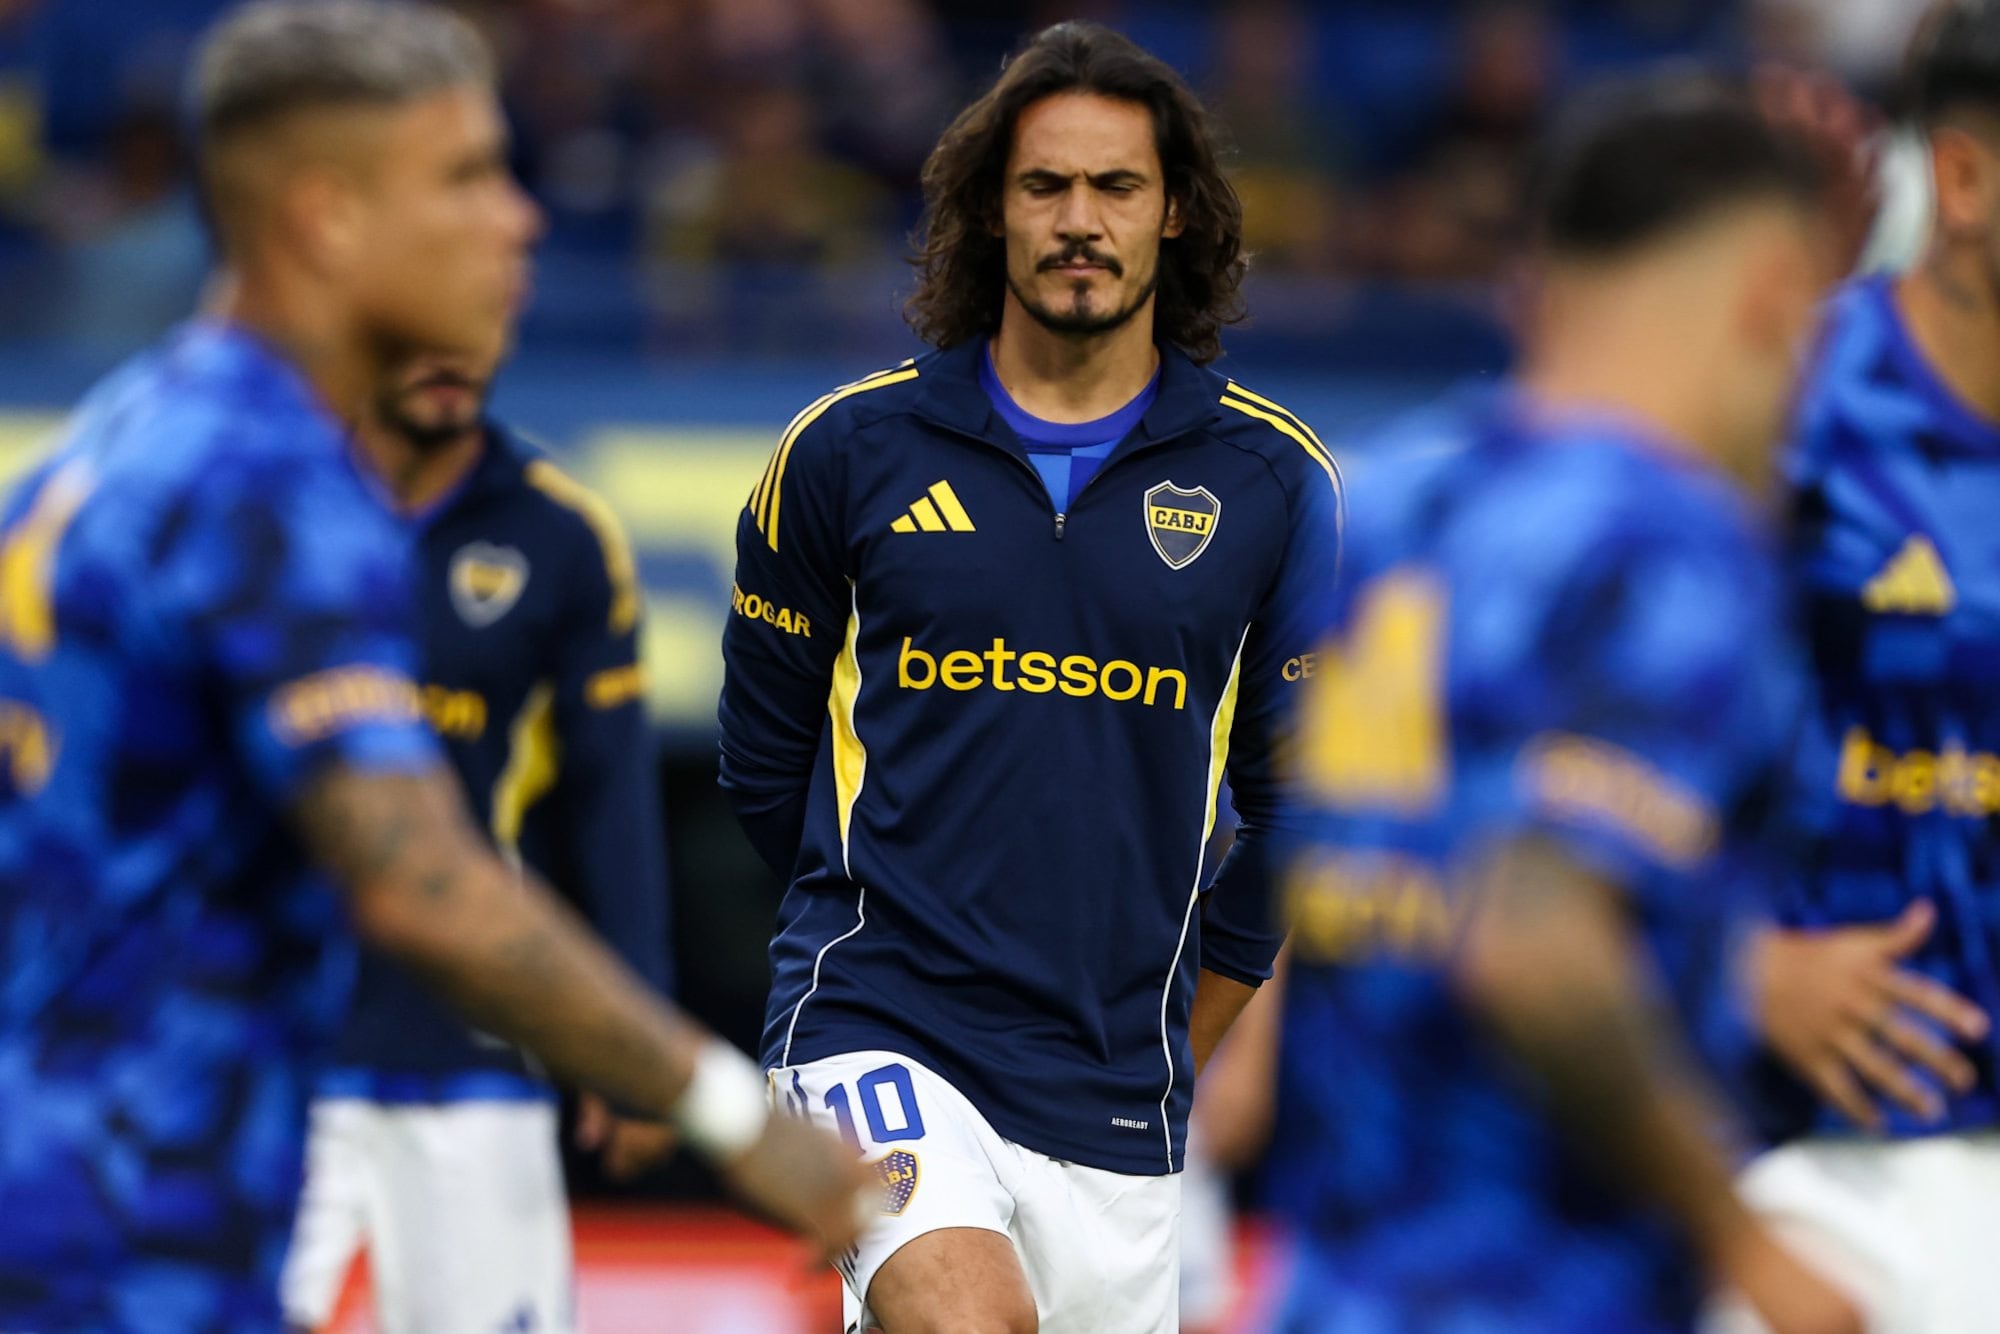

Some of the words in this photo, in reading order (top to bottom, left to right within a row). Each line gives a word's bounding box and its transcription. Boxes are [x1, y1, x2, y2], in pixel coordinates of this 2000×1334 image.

[1155, 510, 1207, 531] CABJ
[898, 636, 1187, 710] betsson
[1281, 653, 1316, 682] CE
[824, 1063, 926, 1154] 10
[1111, 1117, 1149, 1130] AEROREADY
